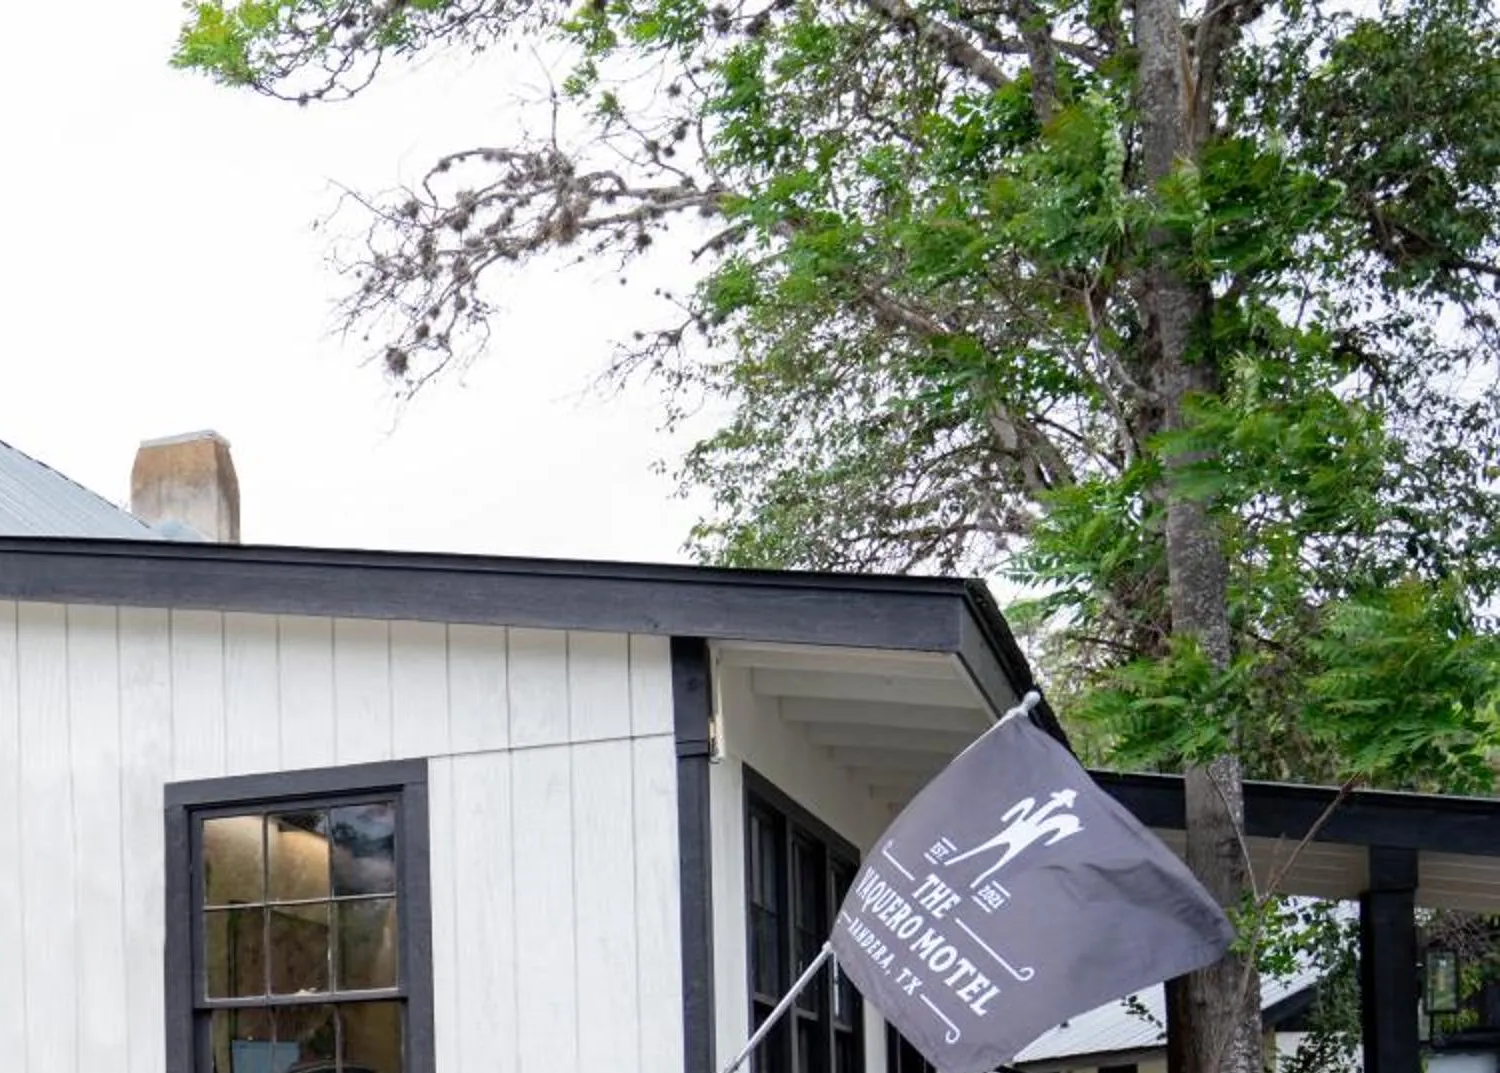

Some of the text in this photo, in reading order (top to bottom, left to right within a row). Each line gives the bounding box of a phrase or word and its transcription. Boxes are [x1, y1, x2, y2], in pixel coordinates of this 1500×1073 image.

[911, 872, 962, 919] THE
[855, 866, 1001, 1017] VAQUERO MOTEL
[895, 967, 924, 995] TX
